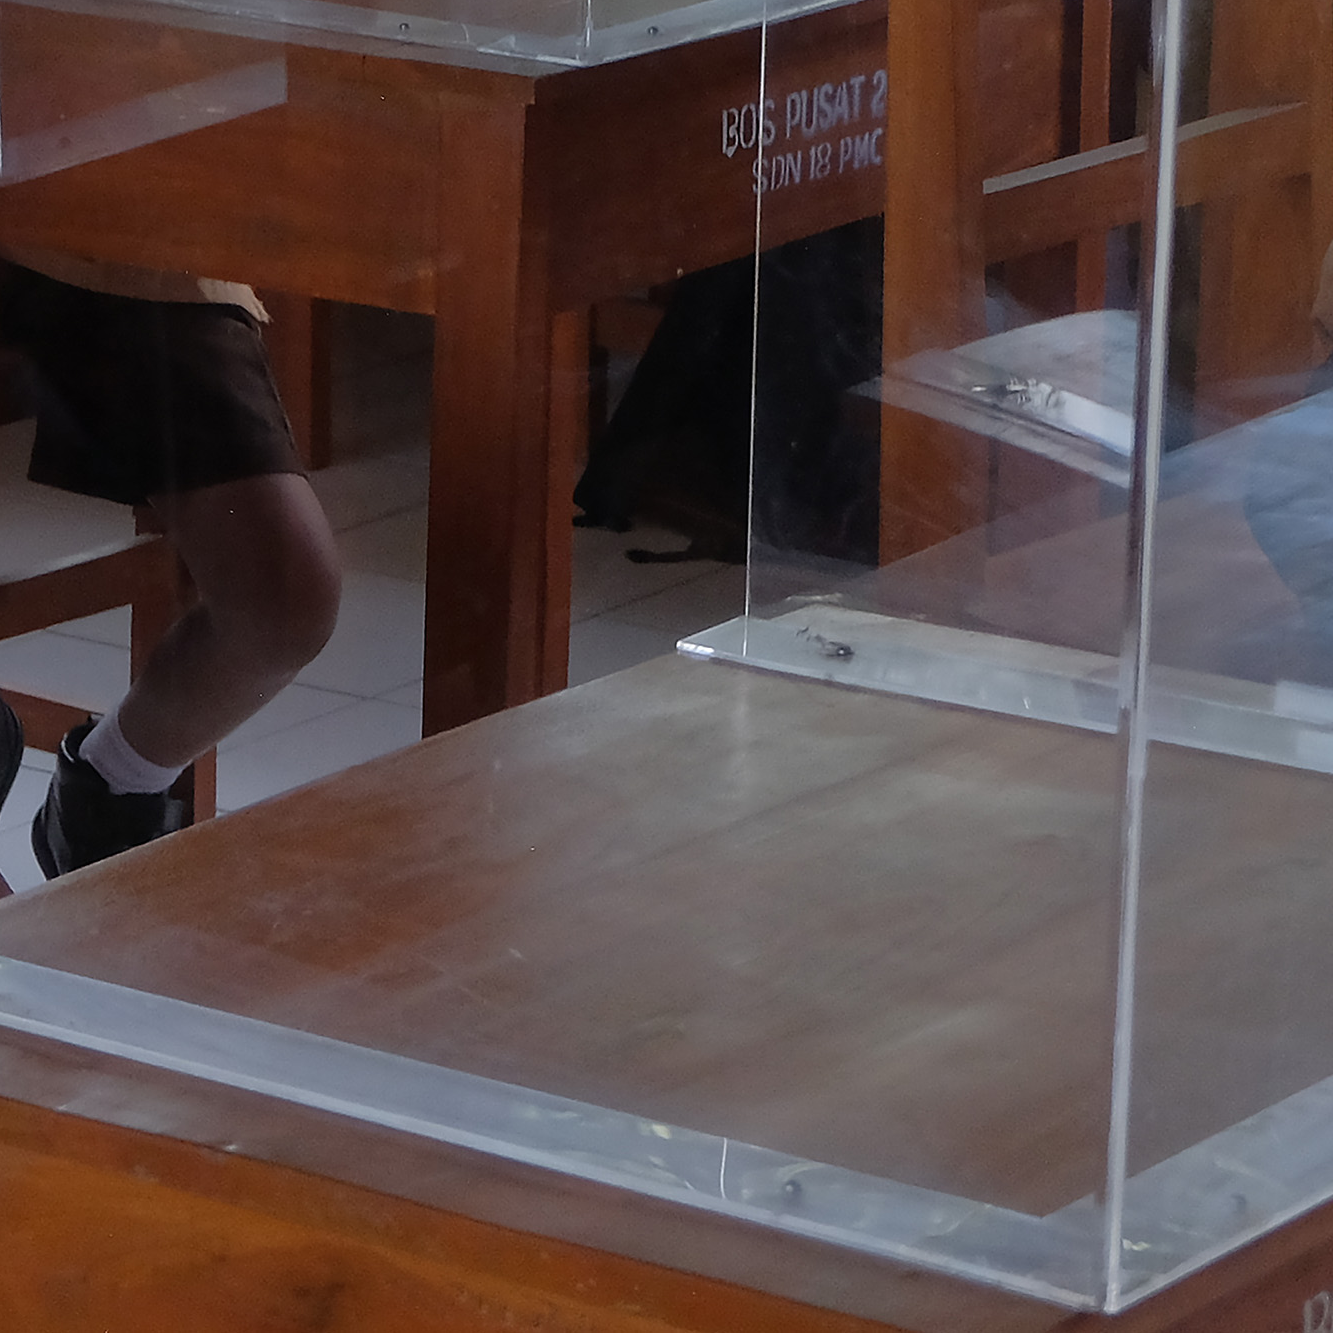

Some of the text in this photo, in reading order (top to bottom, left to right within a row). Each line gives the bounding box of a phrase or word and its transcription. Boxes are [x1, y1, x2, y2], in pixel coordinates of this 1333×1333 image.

[722, 98, 776, 158] BOS
[786, 75, 866, 140] PUSAT
[751, 127, 884, 194] SDN 18 PMC
